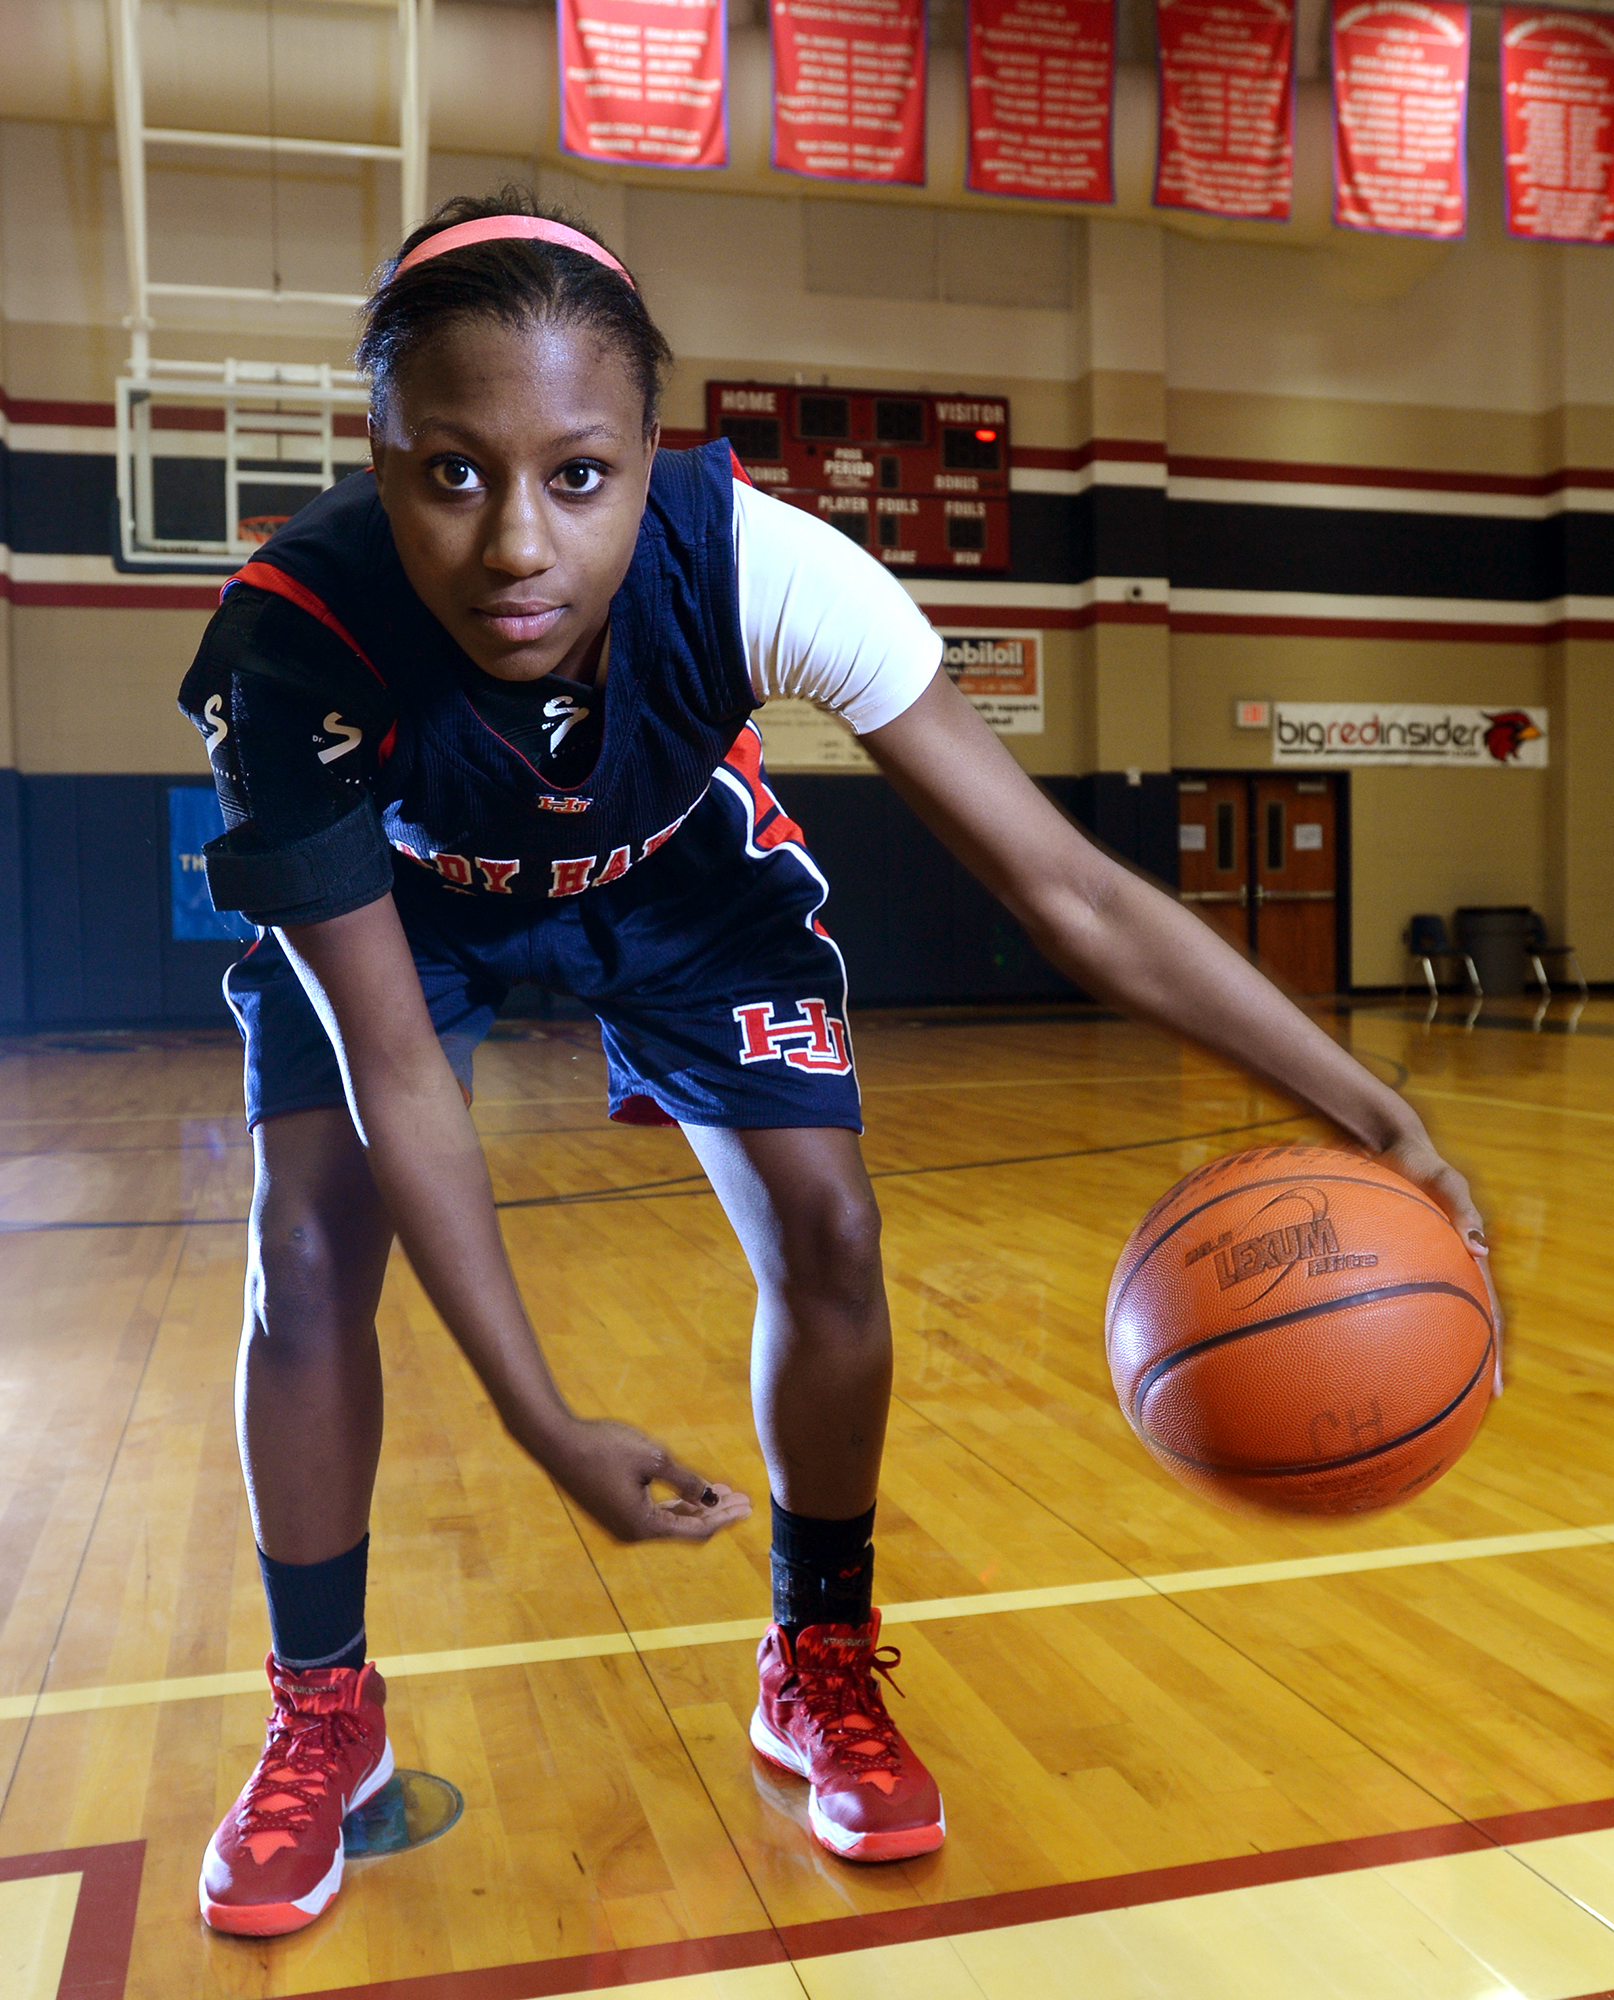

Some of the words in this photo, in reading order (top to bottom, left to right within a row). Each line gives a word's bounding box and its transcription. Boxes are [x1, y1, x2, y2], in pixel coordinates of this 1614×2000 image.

[721, 391, 776, 412] HOME
[936, 402, 1004, 424] VISITOR
[824, 460, 874, 477] PERIOD
[934, 475, 979, 491] BONUS
[818, 495, 869, 512] PLAYER
[876, 498, 918, 514] FOULS
[944, 501, 987, 518] FOULS
[881, 549, 917, 564] GAME
[943, 640, 1023, 665] obiloil
[1278, 713, 1481, 751] bigredinsider
[1213, 1218, 1341, 1291] LEXUM
[1308, 1252, 1379, 1277] Elite
